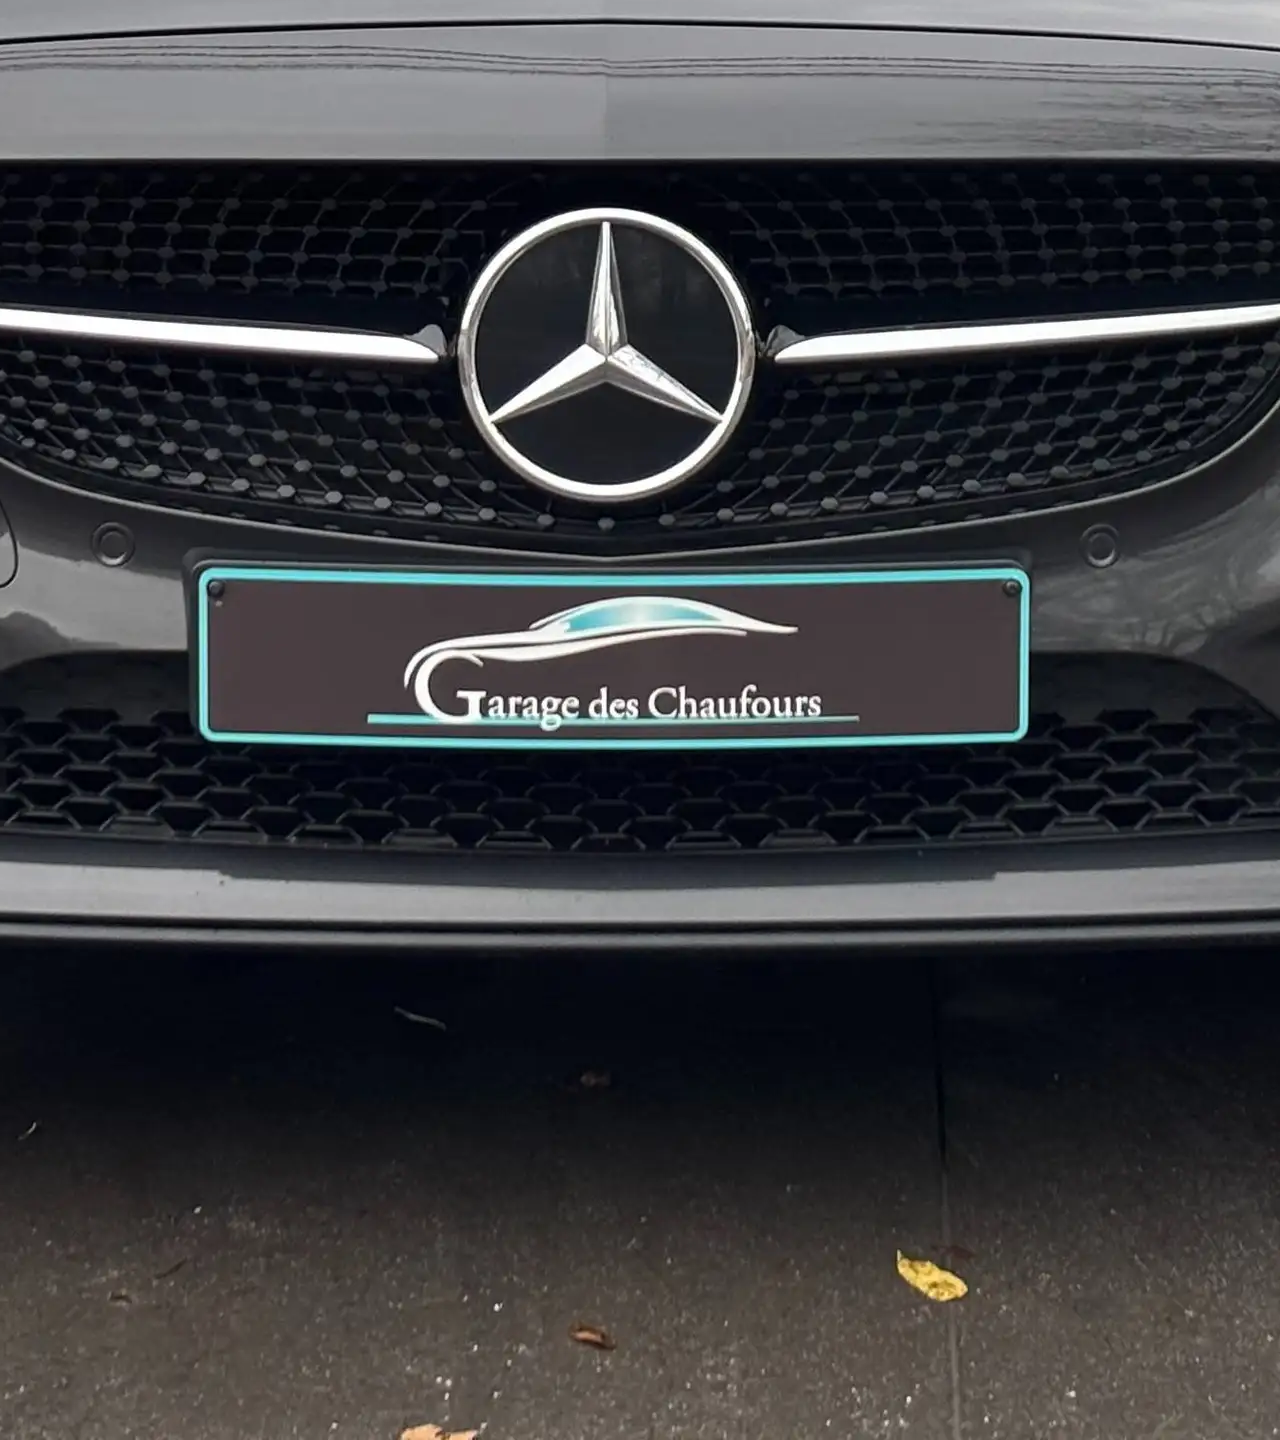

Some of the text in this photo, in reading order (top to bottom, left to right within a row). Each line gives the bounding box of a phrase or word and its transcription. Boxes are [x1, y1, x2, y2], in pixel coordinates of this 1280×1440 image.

[414, 649, 822, 731] Garage des Chaufours
